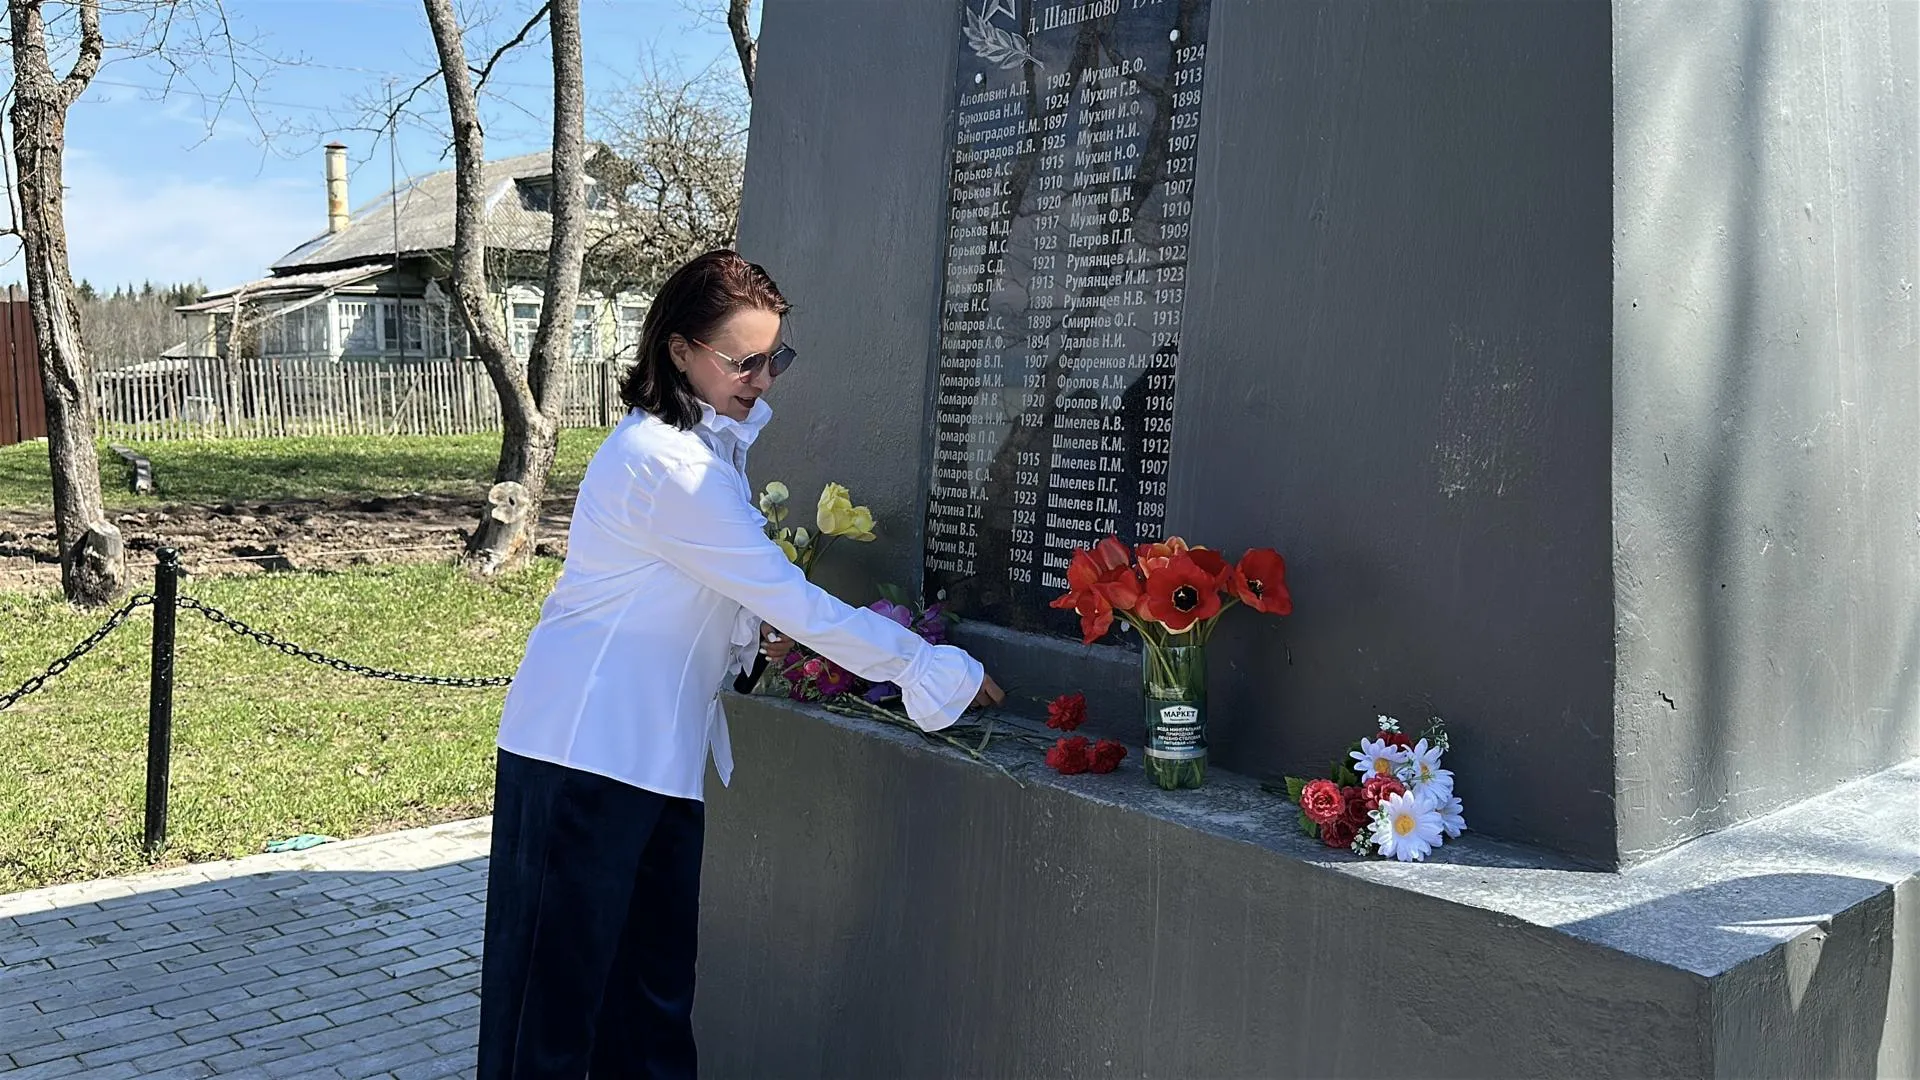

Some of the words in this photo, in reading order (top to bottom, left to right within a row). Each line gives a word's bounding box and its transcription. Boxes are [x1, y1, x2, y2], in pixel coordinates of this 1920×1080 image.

[1026, 17, 1039, 37] д.
[1043, 0, 1120, 31] Шапилово
[1082, 65, 1119, 85] Мухин
[1122, 57, 1147, 75] В.Ф.
[1176, 43, 1206, 64] 1924
[960, 89, 1007, 109] Аполовин
[1010, 82, 1029, 98] А.П.
[1046, 72, 1071, 91] 1902
[1081, 86, 1117, 106] Мухин
[1120, 79, 1140, 96] Г.В.
[1174, 66, 1204, 86] 1913
[959, 110, 1001, 129] Брюхова
[1003, 103, 1023, 119] Н.И.
[1045, 93, 1070, 111] 1924
[1079, 108, 1115, 126] Мухин
[1118, 100, 1143, 118] И.Ф.
[1172, 89, 1202, 108] 1898
[957, 126, 1016, 146] Виноградов
[1018, 119, 1040, 136] Н.М.
[1043, 114, 1068, 131] 1897
[1077, 129, 1114, 147] Мухин
[1116, 122, 1140, 139] Н.И.
[1170, 111, 1200, 130] 1925
[956, 146, 1014, 165] Виноградов
[1016, 140, 1035, 155] Я.Я.
[1042, 134, 1066, 151] 1925
[1075, 150, 1112, 168] Мухин
[1115, 143, 1139, 160] Н.Ф.
[1168, 133, 1198, 152] 1907
[954, 169, 992, 185] Горьков
[995, 163, 1012, 178] А.С.
[1040, 154, 1065, 171] 1915
[1074, 171, 1110, 188] Мухин
[1113, 165, 1136, 181] П.И.
[1166, 156, 1194, 174] 1921
[953, 188, 991, 204] Горьков
[993, 183, 1011, 197] И.С.
[1038, 175, 1063, 191] 1910
[1072, 192, 1108, 209] Мухин
[1111, 186, 1134, 202] П.Н.
[1164, 178, 1193, 196] 1907
[951, 207, 989, 223] Горьков
[991, 202, 1010, 219] Д.С.
[1037, 195, 1061, 211] 1920
[1070, 213, 1107, 229] Мухин
[1109, 207, 1133, 223] Ф.В.
[1162, 200, 1191, 218] 1910
[950, 226, 988, 242] Горьков
[990, 221, 1012, 237] М.Д.
[1035, 215, 1060, 231] 1917
[1069, 233, 1109, 249] Петров
[1112, 228, 1135, 244] П.П.
[1160, 222, 1189, 239] 1909
[949, 245, 987, 260] Горьков
[989, 241, 1009, 255] М.С.
[1034, 236, 1058, 251] 1923
[1067, 253, 1124, 270] Румянцев
[1126, 248, 1149, 263] А.И.
[1158, 244, 1187, 261] 1922
[947, 265, 985, 279] Горьков
[987, 260, 1006, 276] С.Д.
[1032, 256, 1055, 271] 1921
[1065, 274, 1122, 291] Румянцев
[1125, 269, 1149, 284] И.И.
[1156, 266, 1186, 282] 1923
[946, 283, 984, 298] Горьков
[986, 280, 1005, 293] П.К.
[1030, 276, 1055, 290] 1913
[945, 302, 969, 317] Гусев
[971, 300, 989, 313] Н.С.
[1029, 296, 1053, 310] 1898
[1064, 295, 1120, 311] Румянцев
[1123, 291, 1146, 305] Н.В.
[1154, 288, 1184, 304] 1913
[943, 320, 985, 334] Комаров
[987, 318, 1004, 331] А.С.
[1027, 316, 1051, 330] 1898
[1062, 315, 1112, 331] Смирнов
[1114, 312, 1136, 327] Ф.Г.
[1152, 310, 1182, 325] 1913
[942, 339, 983, 353] Комаров
[985, 337, 1006, 350] А.Ф.
[1026, 336, 1050, 349] 1894
[1060, 335, 1100, 351] Удалов
[1102, 334, 1125, 348] Н.И.
[1151, 332, 1180, 347] 1924
[941, 357, 982, 372] Комаров
[984, 356, 1003, 369] В.П.
[1024, 356, 1048, 369] 1907
[1058, 355, 1126, 371] Федоренков
[1128, 354, 1148, 368] А.Н.
[1149, 354, 1178, 368] 1920
[939, 376, 981, 390] Комаров
[983, 375, 1004, 388] М.И.
[1023, 375, 1045, 388] 1921
[1057, 375, 1100, 392] Фролов
[1102, 375, 1126, 389] А.М.
[1147, 375, 1176, 389] 1917
[938, 394, 979, 409] Комаров
[1021, 395, 1045, 408] 1920
[1055, 395, 1098, 412] Фролов
[1100, 396, 1125, 410] И.Ф.
[1145, 397, 1174, 411] 1916
[937, 412, 983, 428] Комарова
[1020, 414, 1043, 428] 1924
[1054, 415, 1100, 430] Шмелев
[1102, 417, 1124, 431] А.В.
[1143, 418, 1172, 432] 1926
[935, 430, 976, 446] Комаров
[1053, 435, 1098, 450] Шмелев
[1101, 437, 1125, 452] К.М.
[1141, 439, 1170, 454] 1912
[934, 448, 975, 465] Комаров
[977, 451, 995, 464] П.А.
[1017, 453, 1040, 467] 1915
[1051, 455, 1097, 471] Шмелев
[1099, 458, 1124, 472] П.М.
[1139, 460, 1168, 475] 1907
[933, 466, 973, 483] Комаров
[975, 469, 992, 483] С.А.
[1015, 472, 1039, 486] 1924
[1049, 475, 1095, 491] Шмелев
[1098, 478, 1118, 493] П.Г.
[1138, 481, 1166, 497] 1918
[931, 484, 968, 500] Круглов
[970, 488, 989, 501] Н.А.
[1013, 491, 1037, 506] 1923
[1048, 494, 1093, 511] Шмелев
[1096, 498, 1121, 514] П.М.
[1136, 502, 1164, 518] 1898
[929, 502, 965, 518] Мухина
[966, 506, 984, 520] Т.И.
[1012, 510, 1035, 525] 1924
[928, 520, 958, 536] Мухин
[960, 524, 978, 538] В.Б.
[1010, 529, 1034, 545] 1923
[1046, 514, 1092, 531] Шмелев
[1094, 519, 1117, 534] С.М.
[1134, 523, 1161, 539] 1921
[927, 538, 956, 554] Мухин
[958, 542, 977, 559] В.Д.
[1009, 549, 1032, 564] 1924
[1045, 533, 1090, 552] Шмелев
[925, 556, 955, 572] Мухин
[957, 560, 976, 577] В.Д.
[1007, 567, 1031, 583] 1926
